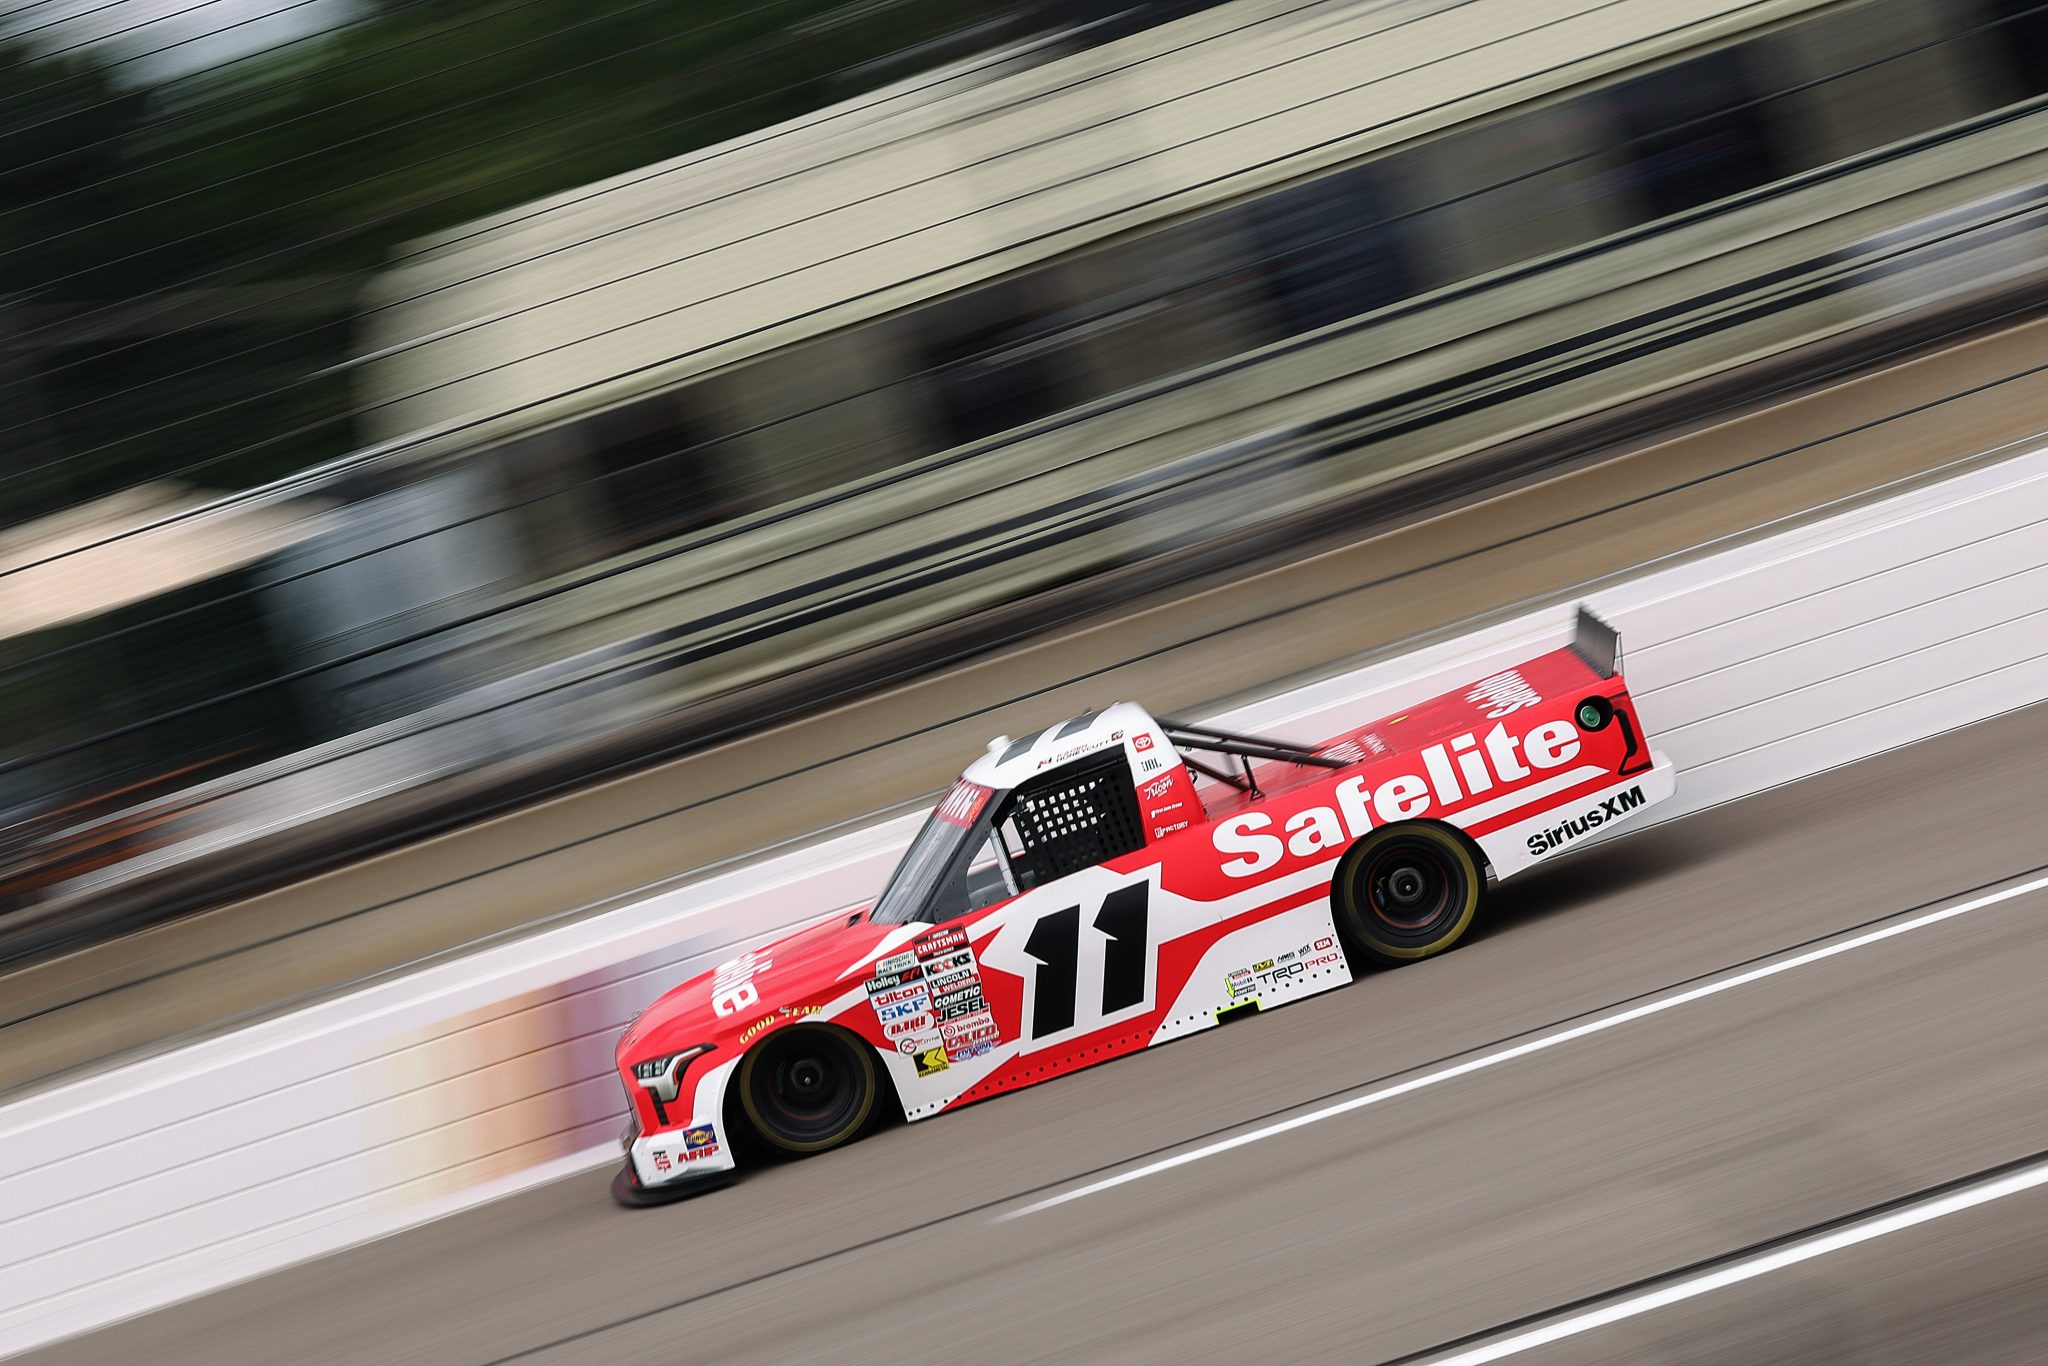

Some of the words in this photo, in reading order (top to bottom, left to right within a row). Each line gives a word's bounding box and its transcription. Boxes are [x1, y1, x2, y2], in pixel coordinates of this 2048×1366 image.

[1141, 758, 1163, 773] JBL
[1211, 719, 1582, 879] Safelite
[1526, 784, 1647, 857] SiriusXM
[917, 932, 966, 955] CRAFTSMAN
[1297, 944, 1311, 955] WIX
[894, 960, 913, 972] TRUCK
[926, 953, 972, 977] KOOKS
[1023, 878, 1150, 1041] 11
[1256, 962, 1305, 984] TRD
[1305, 952, 1339, 970] PRO
[867, 973, 901, 993] Holley
[931, 970, 970, 989] LINCOLN
[942, 977, 976, 993] WELDERS
[874, 984, 925, 1006] tilton
[934, 985, 981, 1009] COMETIC
[881, 997, 927, 1023] SKF
[937, 999, 990, 1023] JESEL
[956, 1016, 991, 1032] brembo
[946, 1025, 997, 1049] CALICO
[677, 1145, 719, 1164] ARP
